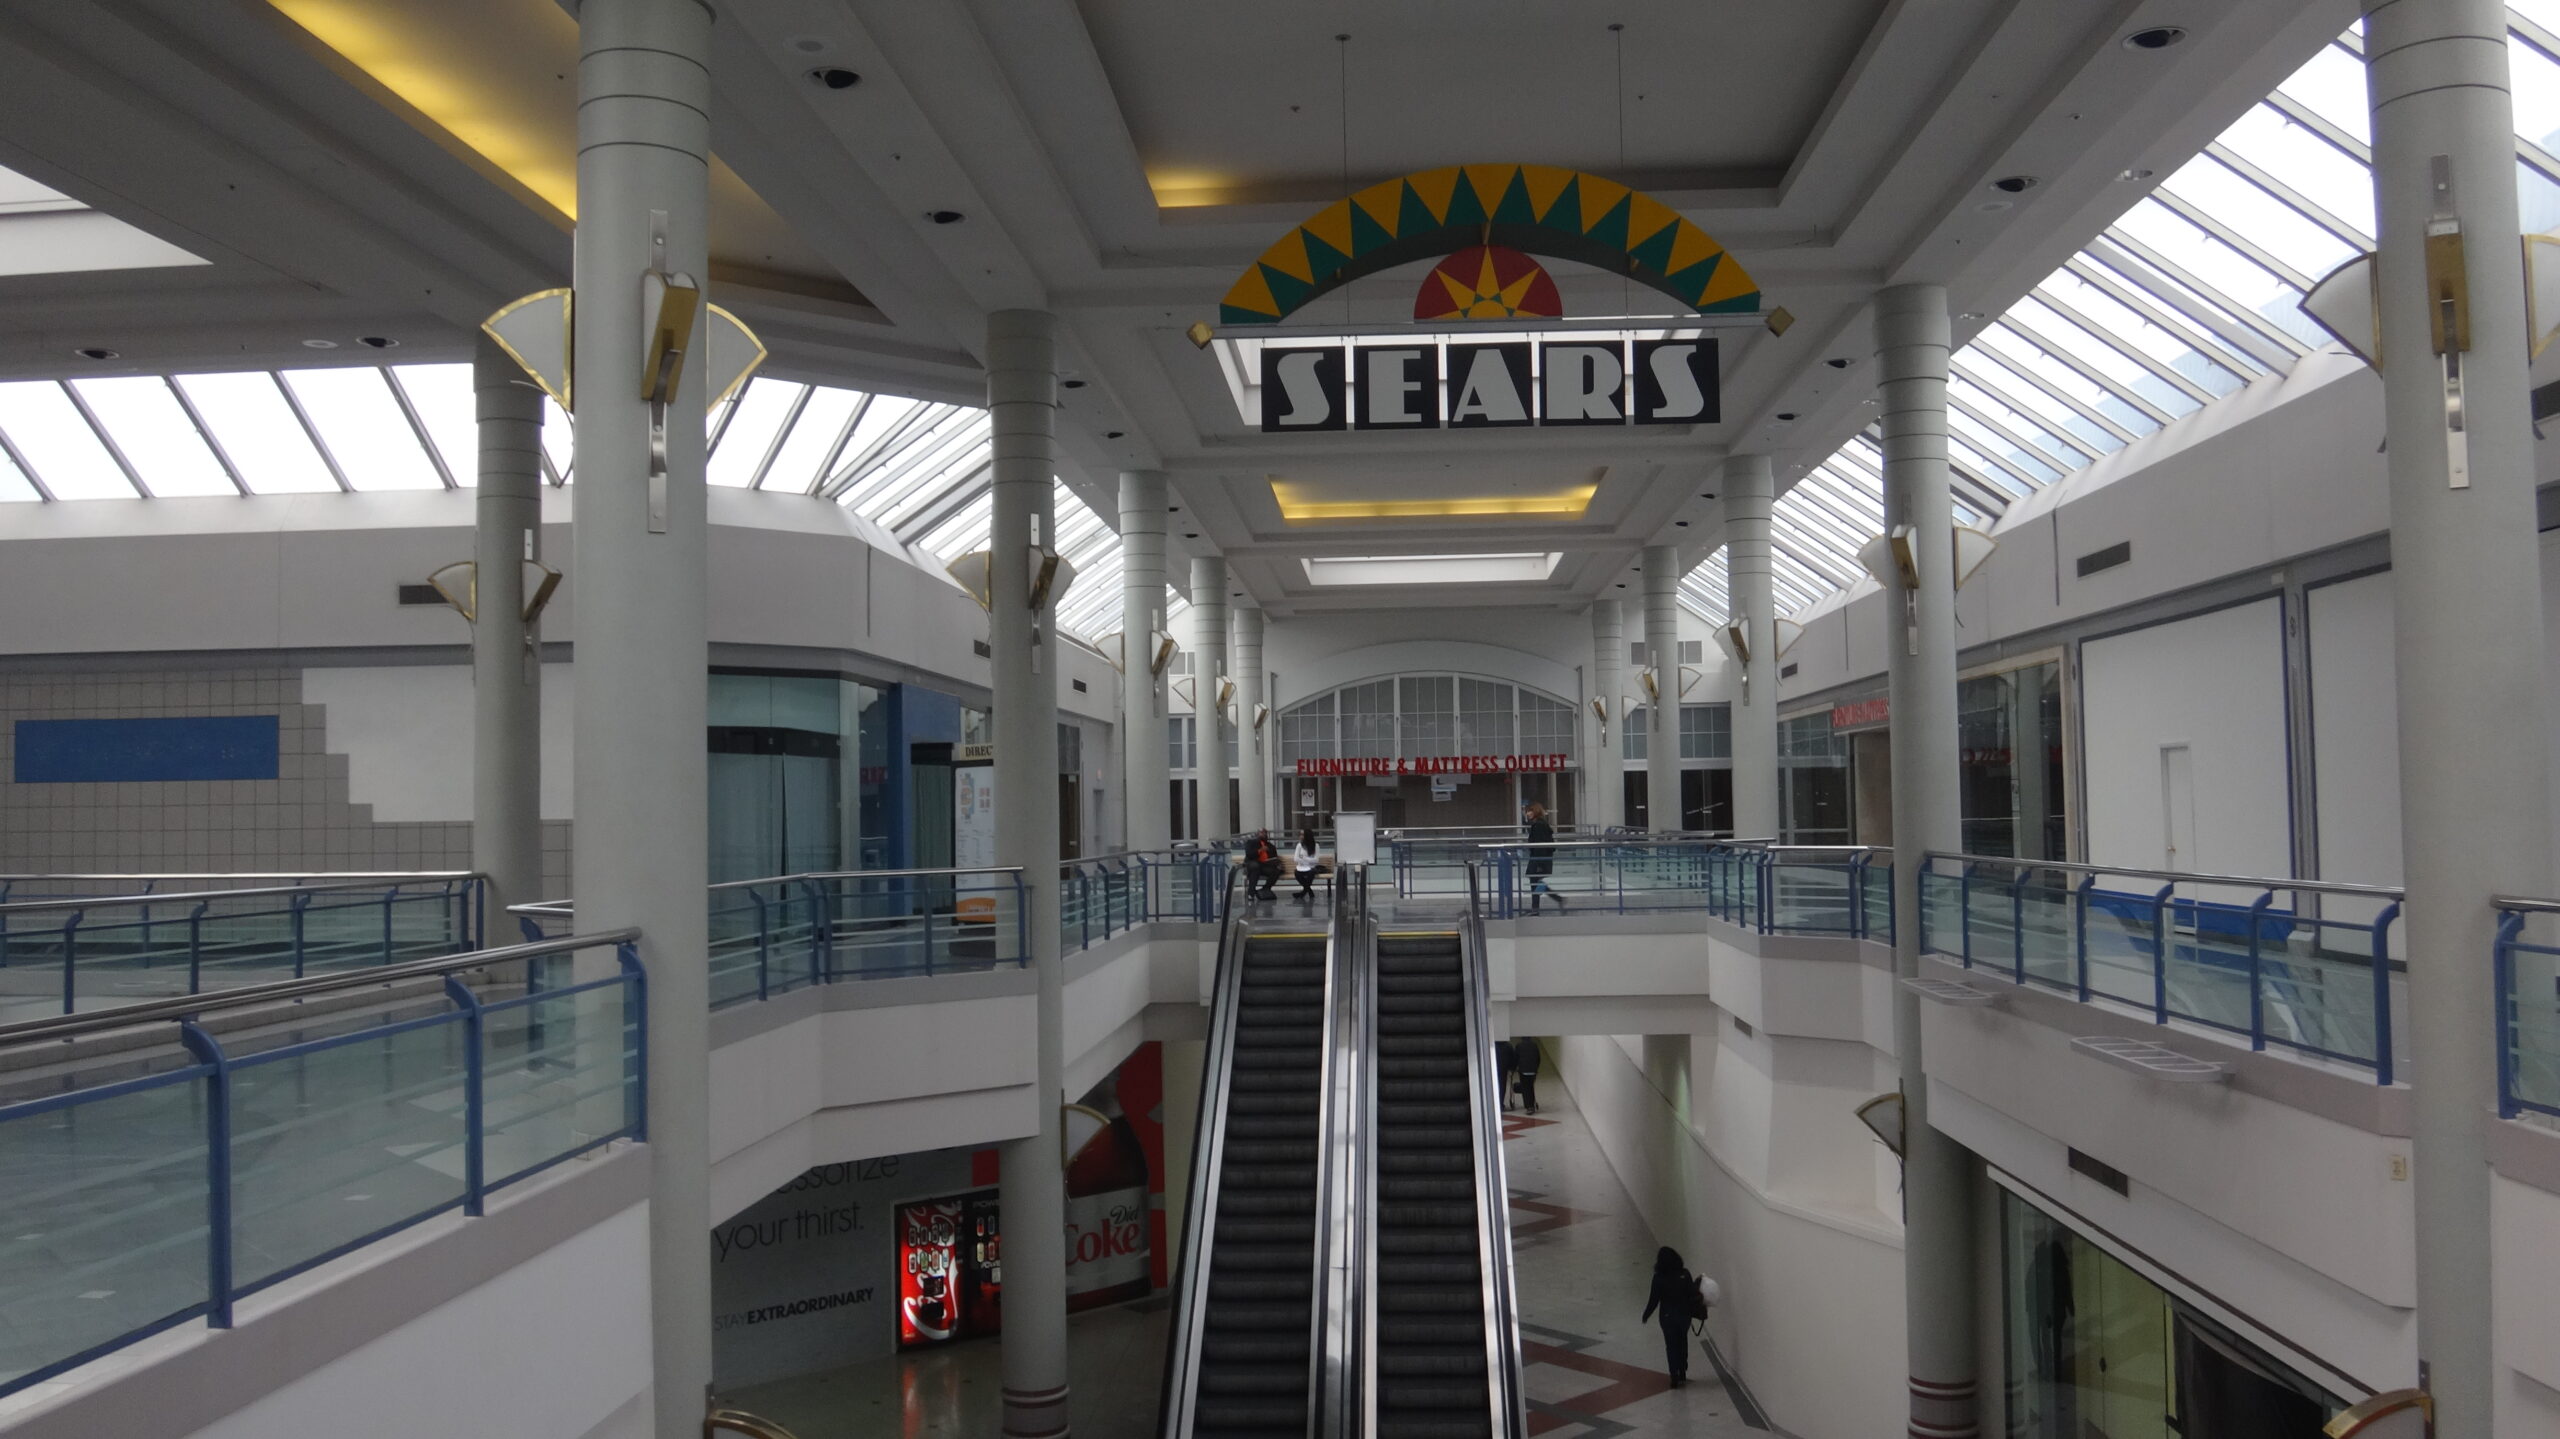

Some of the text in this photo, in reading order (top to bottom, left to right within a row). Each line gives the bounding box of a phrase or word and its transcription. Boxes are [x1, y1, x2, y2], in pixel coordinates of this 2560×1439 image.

[1276, 344, 1704, 426] SEARS
[965, 745, 993, 757] DIREC
[1297, 753, 1567, 776] FURNITURE & MATTRESS OUTLET
[714, 1201, 865, 1263] your thirst.
